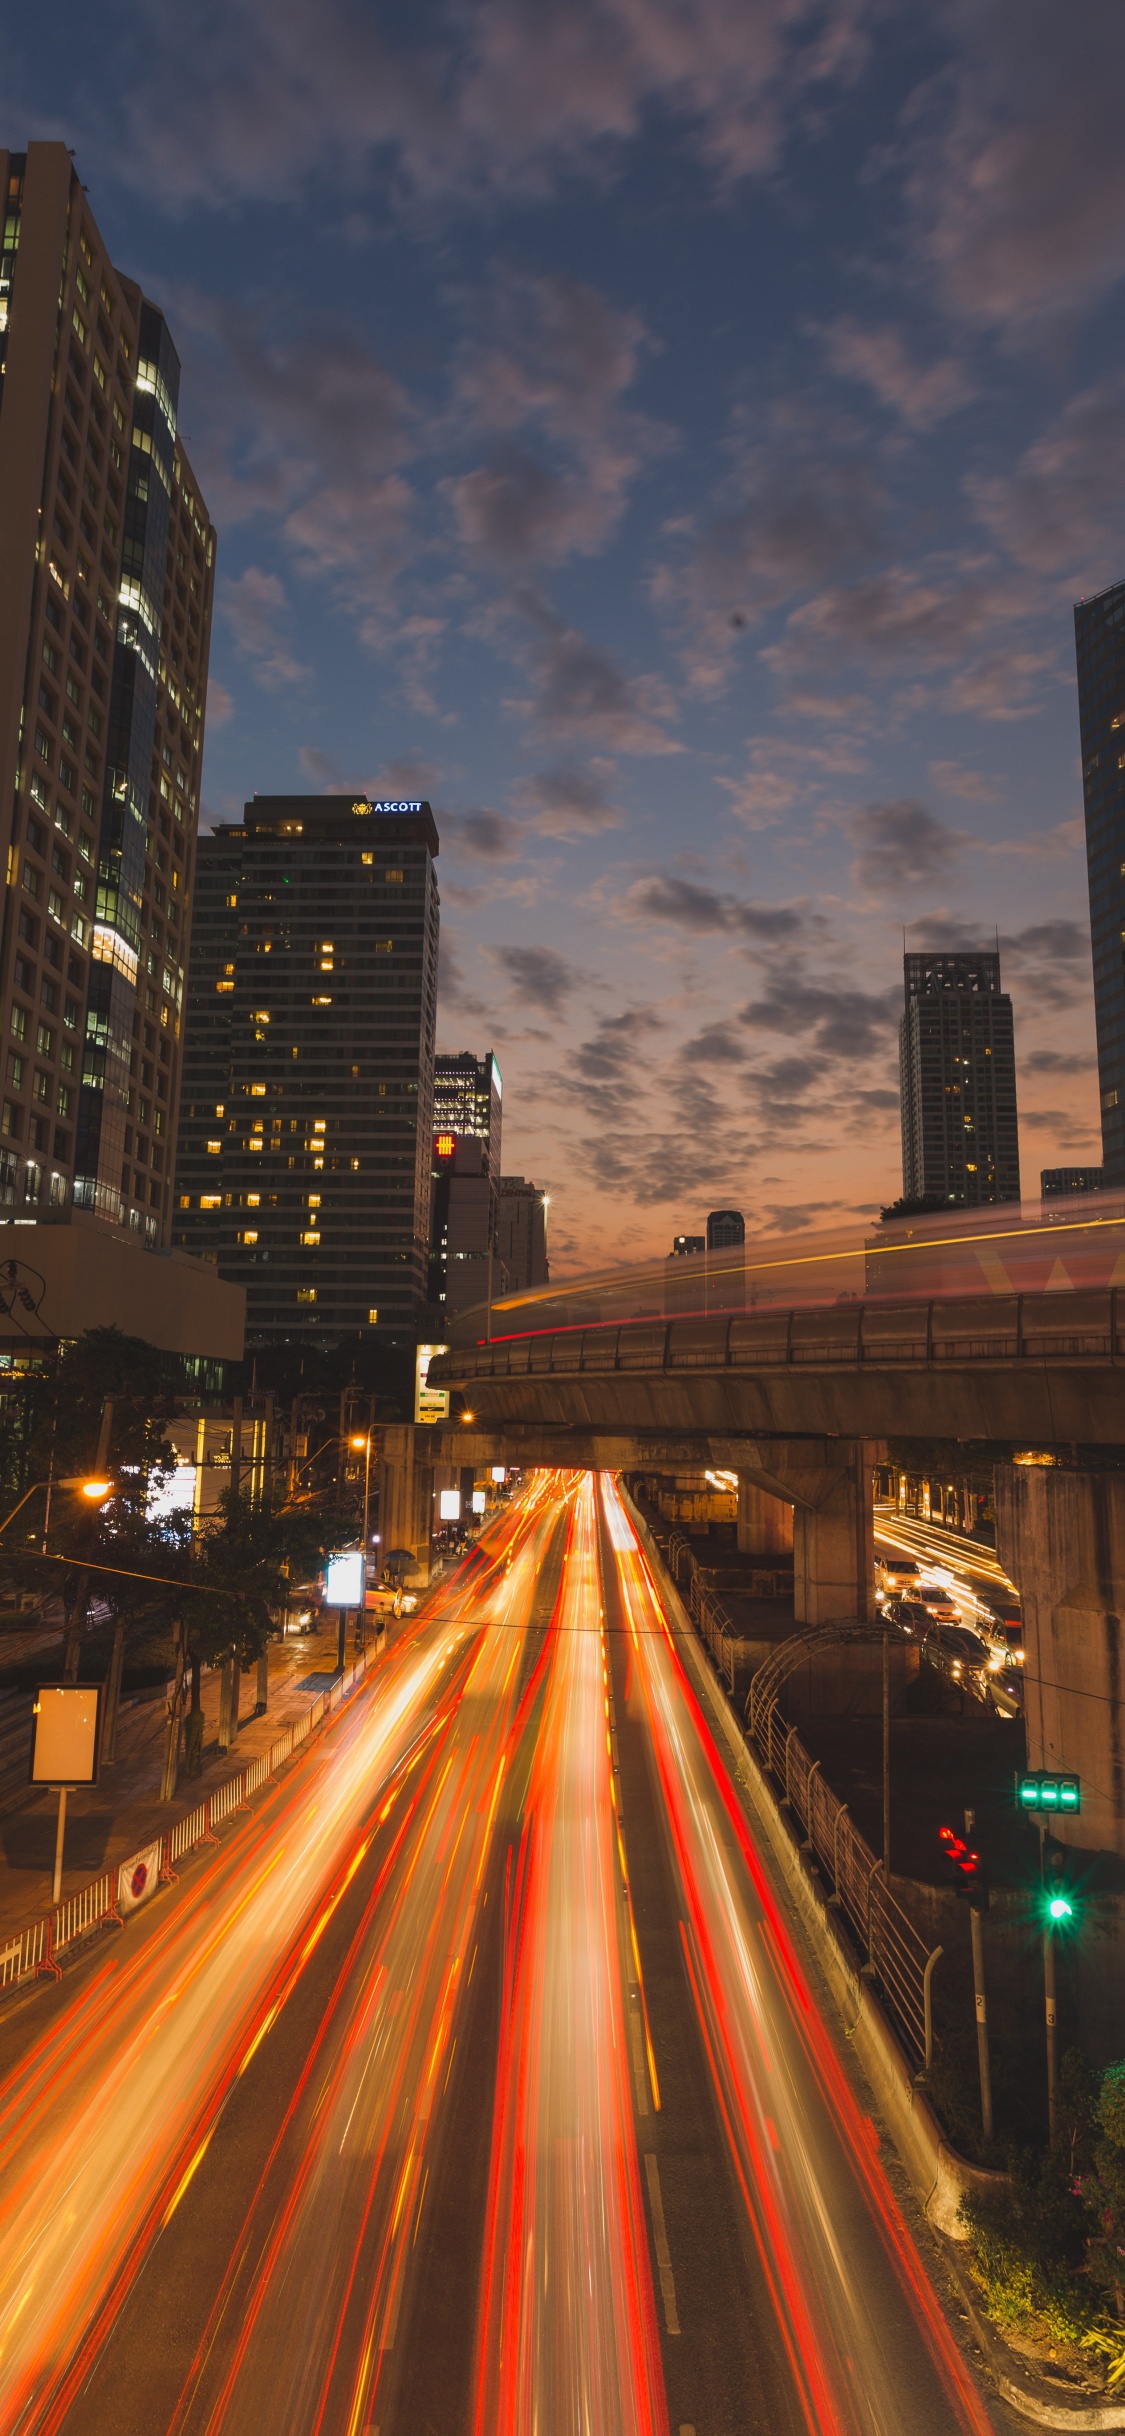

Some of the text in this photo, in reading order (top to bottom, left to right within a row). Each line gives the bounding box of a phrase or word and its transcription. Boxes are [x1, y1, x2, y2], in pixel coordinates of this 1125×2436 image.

[374, 802, 422, 812] ASCOTT
[500, 1189, 533, 1197] DENTIAL
[976, 1996, 983, 2007] 2
[1048, 2013, 1055, 2024] 3
